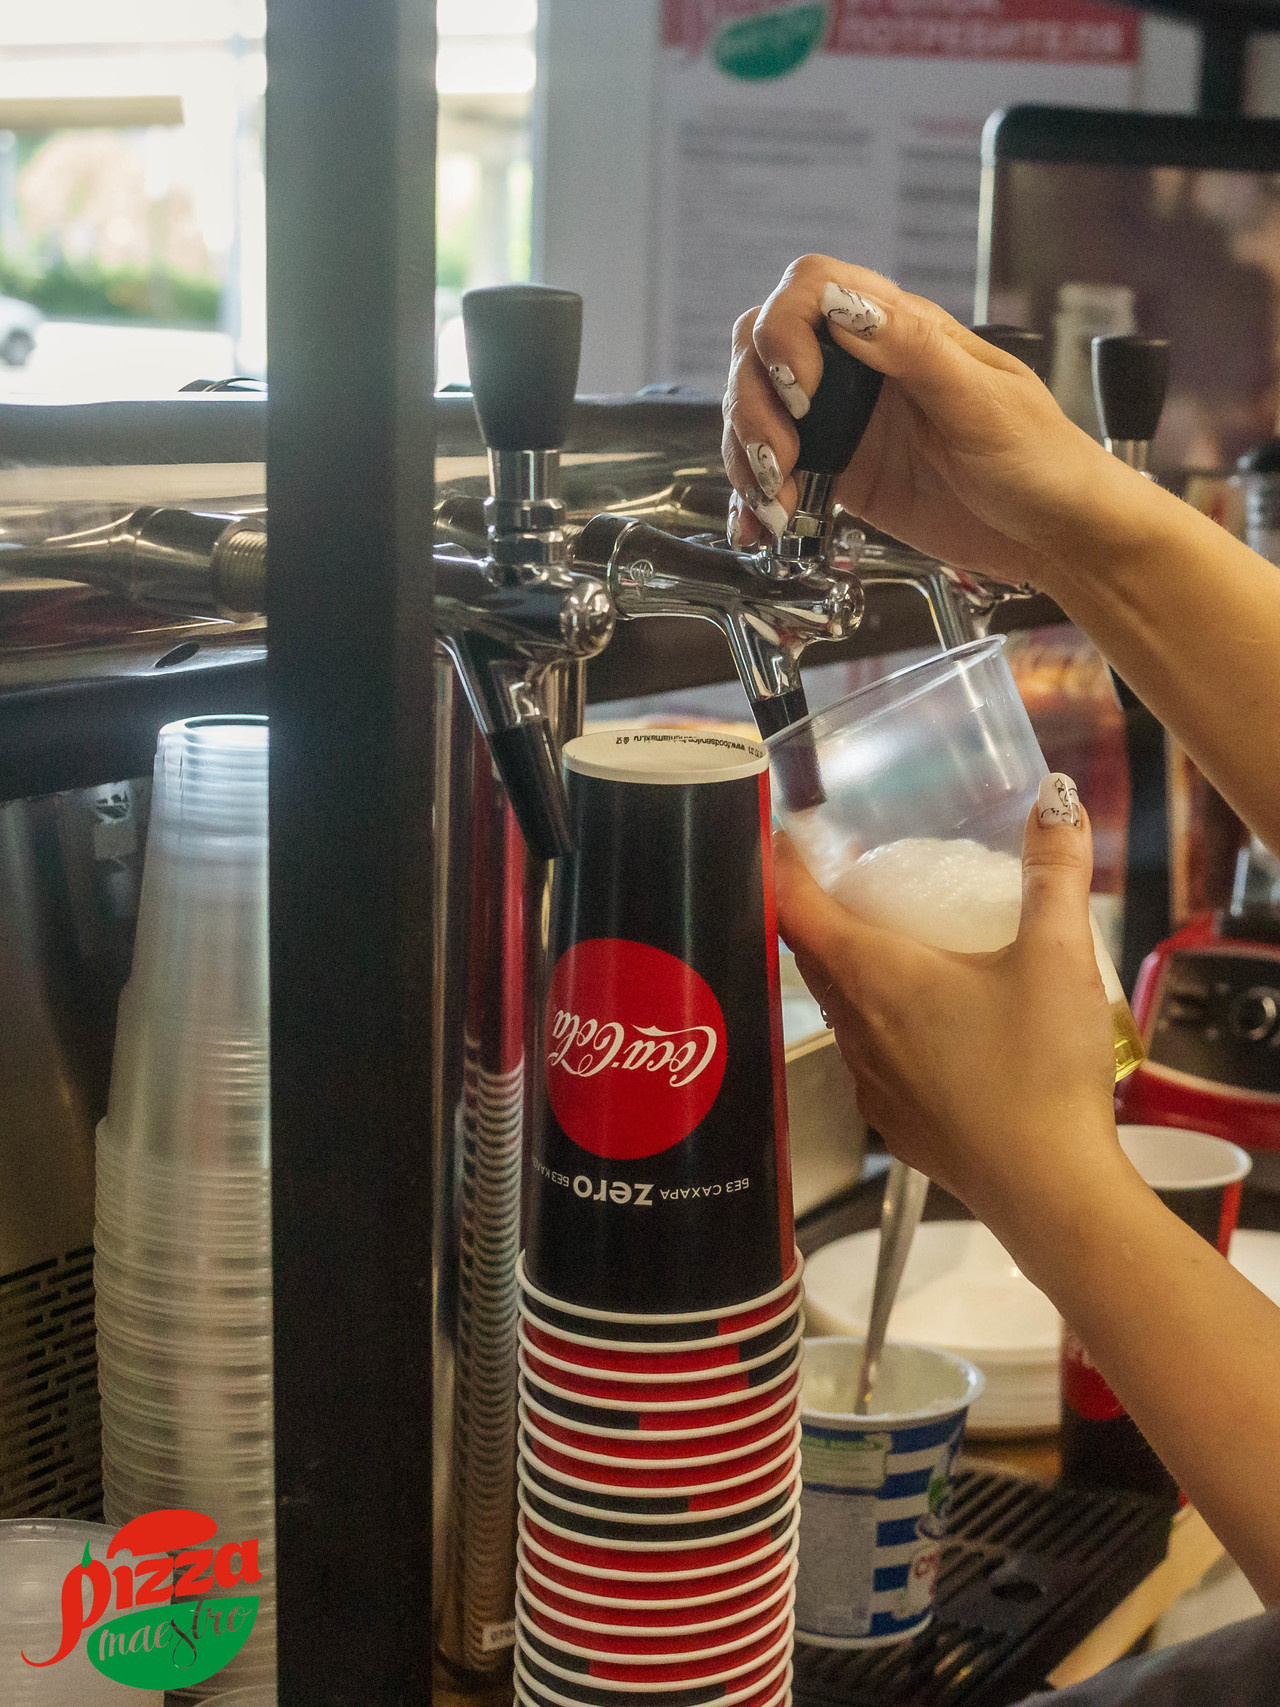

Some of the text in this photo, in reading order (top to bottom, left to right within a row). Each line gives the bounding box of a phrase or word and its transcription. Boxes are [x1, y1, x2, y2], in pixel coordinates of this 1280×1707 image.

[547, 1010, 717, 1087] Coca-Cola
[551, 1171, 570, 1188] БЕЗ
[725, 1177, 750, 1194] БЕЗ
[573, 1175, 655, 1206] zero
[659, 1184, 722, 1200] САХАРА
